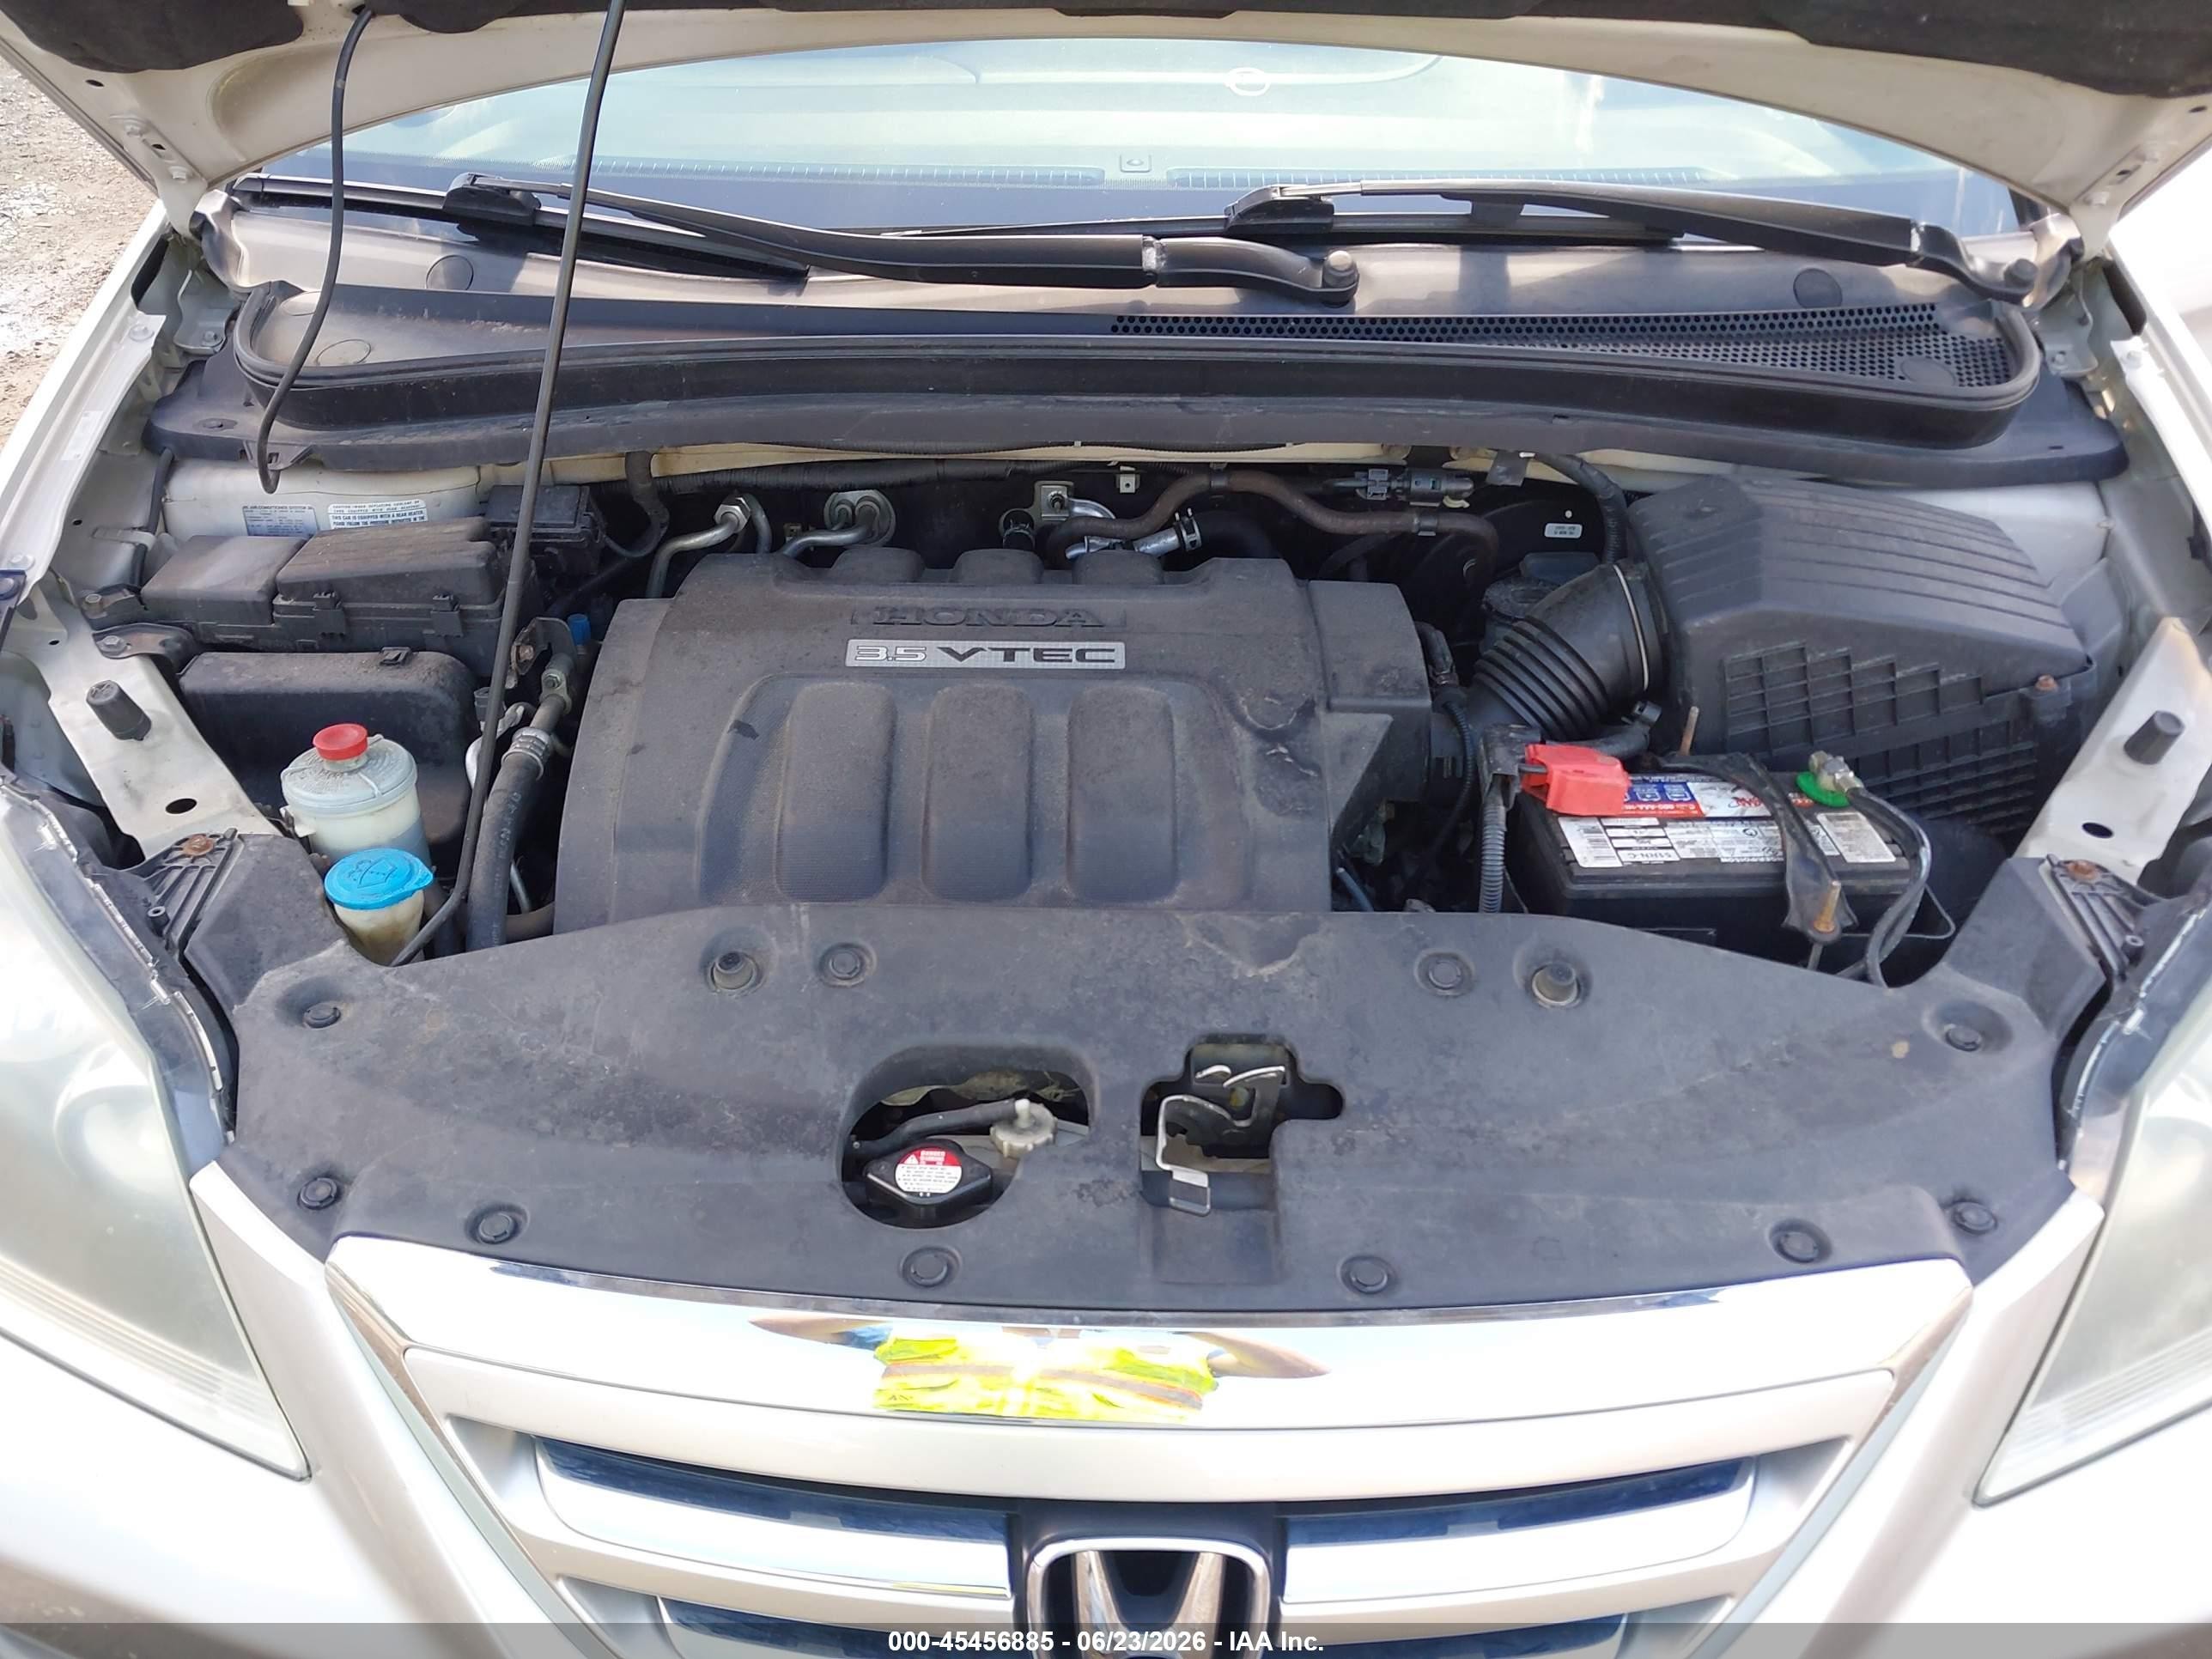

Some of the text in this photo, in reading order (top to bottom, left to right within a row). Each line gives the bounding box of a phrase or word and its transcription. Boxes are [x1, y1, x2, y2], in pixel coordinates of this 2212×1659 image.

[872, 606, 1103, 627] HONDA
[856, 646, 1115, 663] 3.5 VTEC
